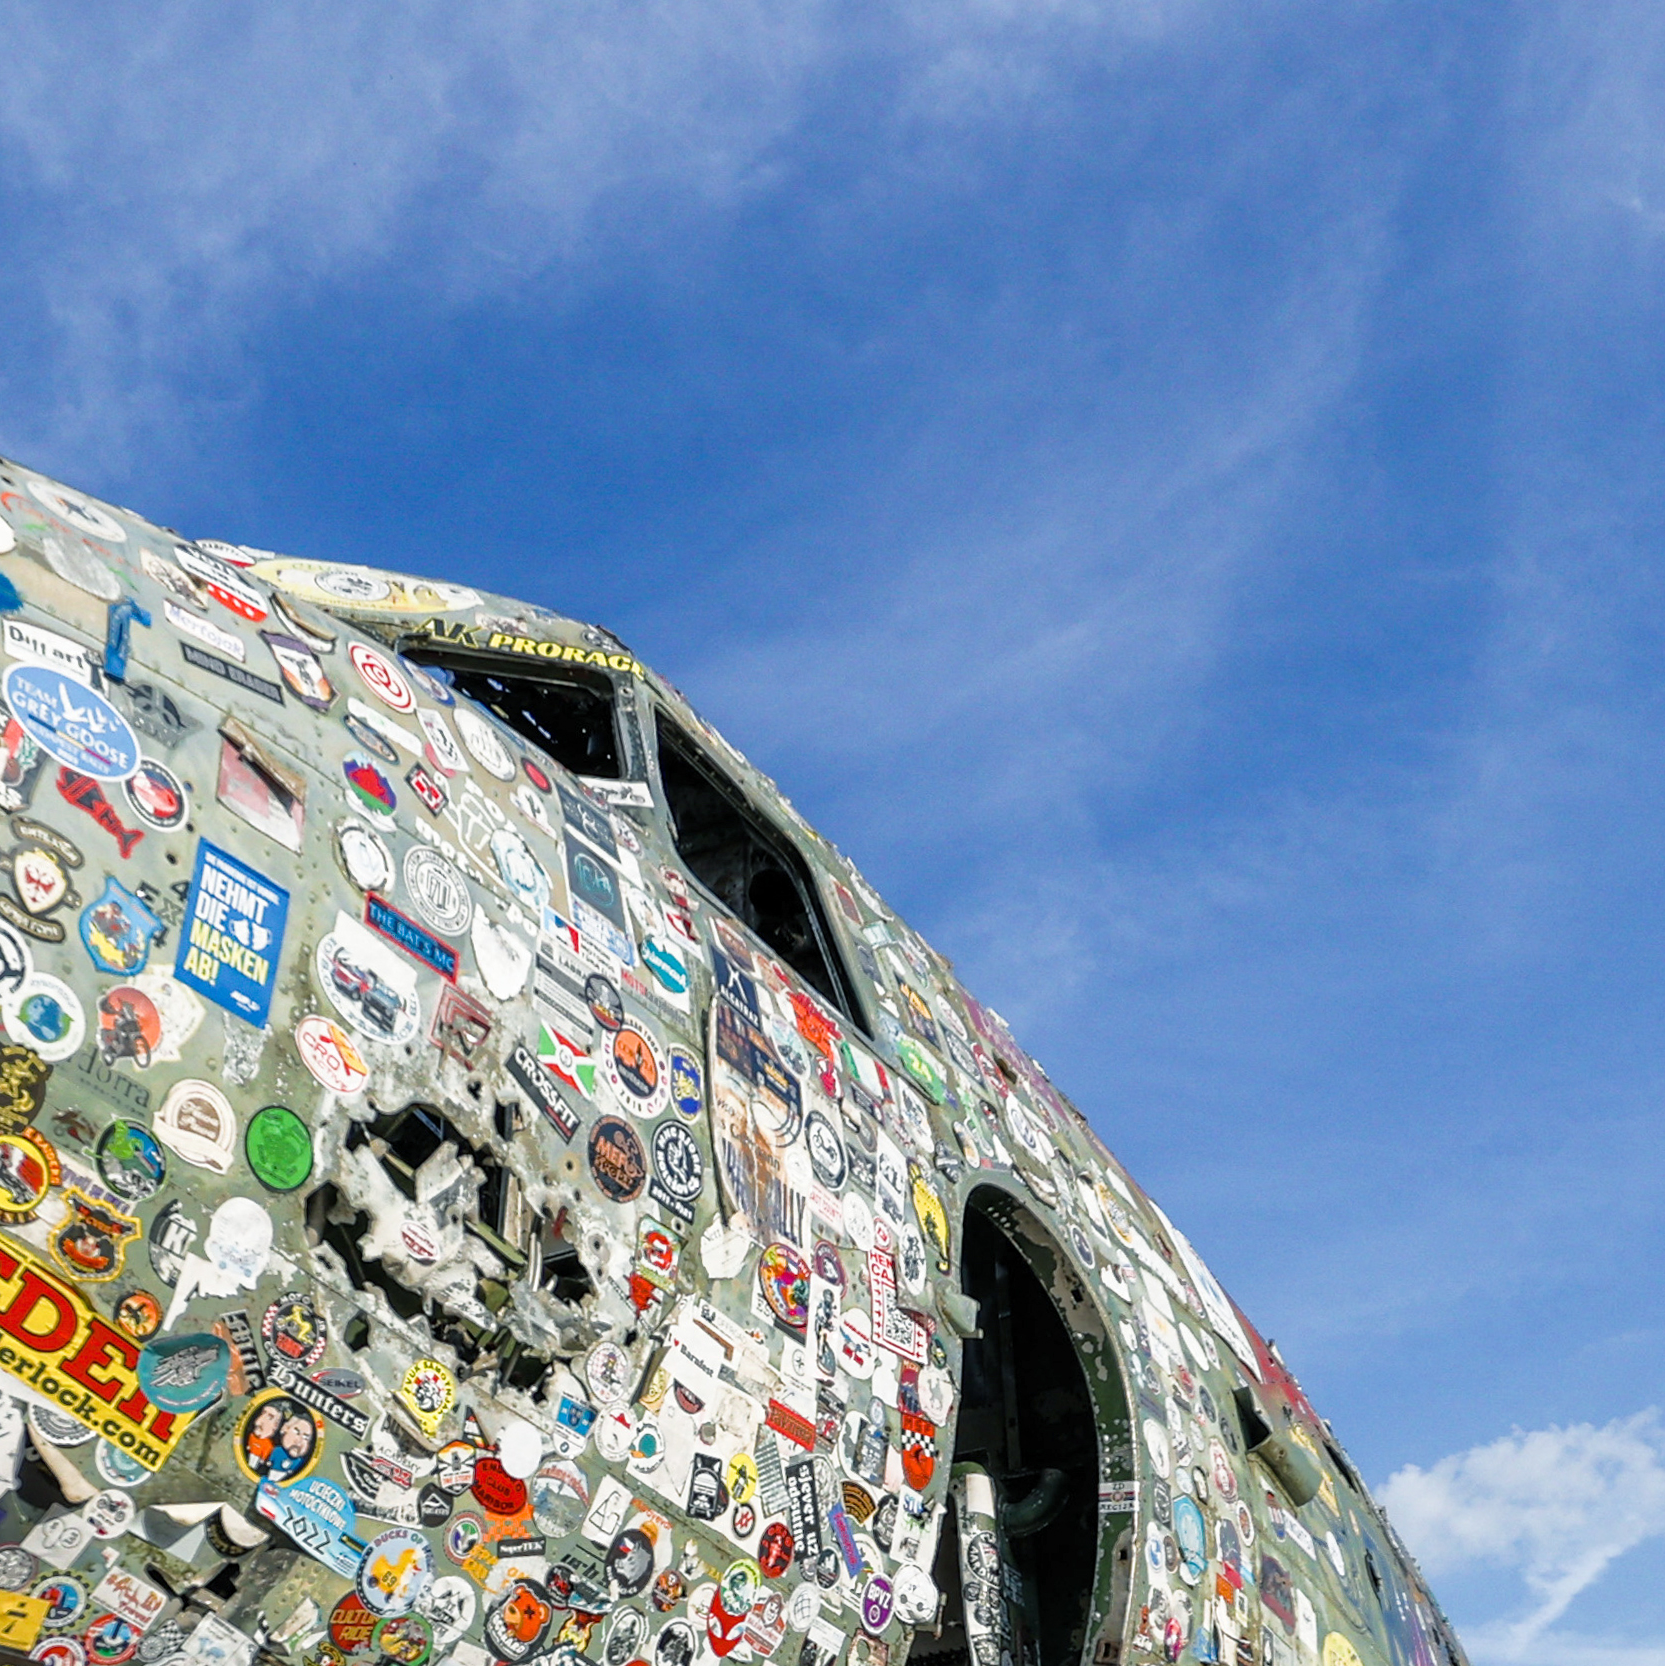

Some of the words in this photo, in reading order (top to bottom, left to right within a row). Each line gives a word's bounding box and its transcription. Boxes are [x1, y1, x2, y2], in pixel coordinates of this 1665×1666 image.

[415, 618, 485, 649] AK
[15, 674, 60, 709] TEAM
[11, 690, 65, 727] GREY
[65, 722, 128, 771] GOOSE
[200, 861, 269, 922] NEHMT
[194, 895, 229, 931] DIE
[183, 948, 219, 986] AB!
[188, 923, 271, 985] MASKEN
[513, 1045, 580, 1132] CROSSFIT
[269, 1363, 369, 1438] Hunters
[318, 1377, 363, 1390] SEIKEL
[485, 1476, 511, 1498] CLUB
[373, 1529, 408, 1548] DUCKS
